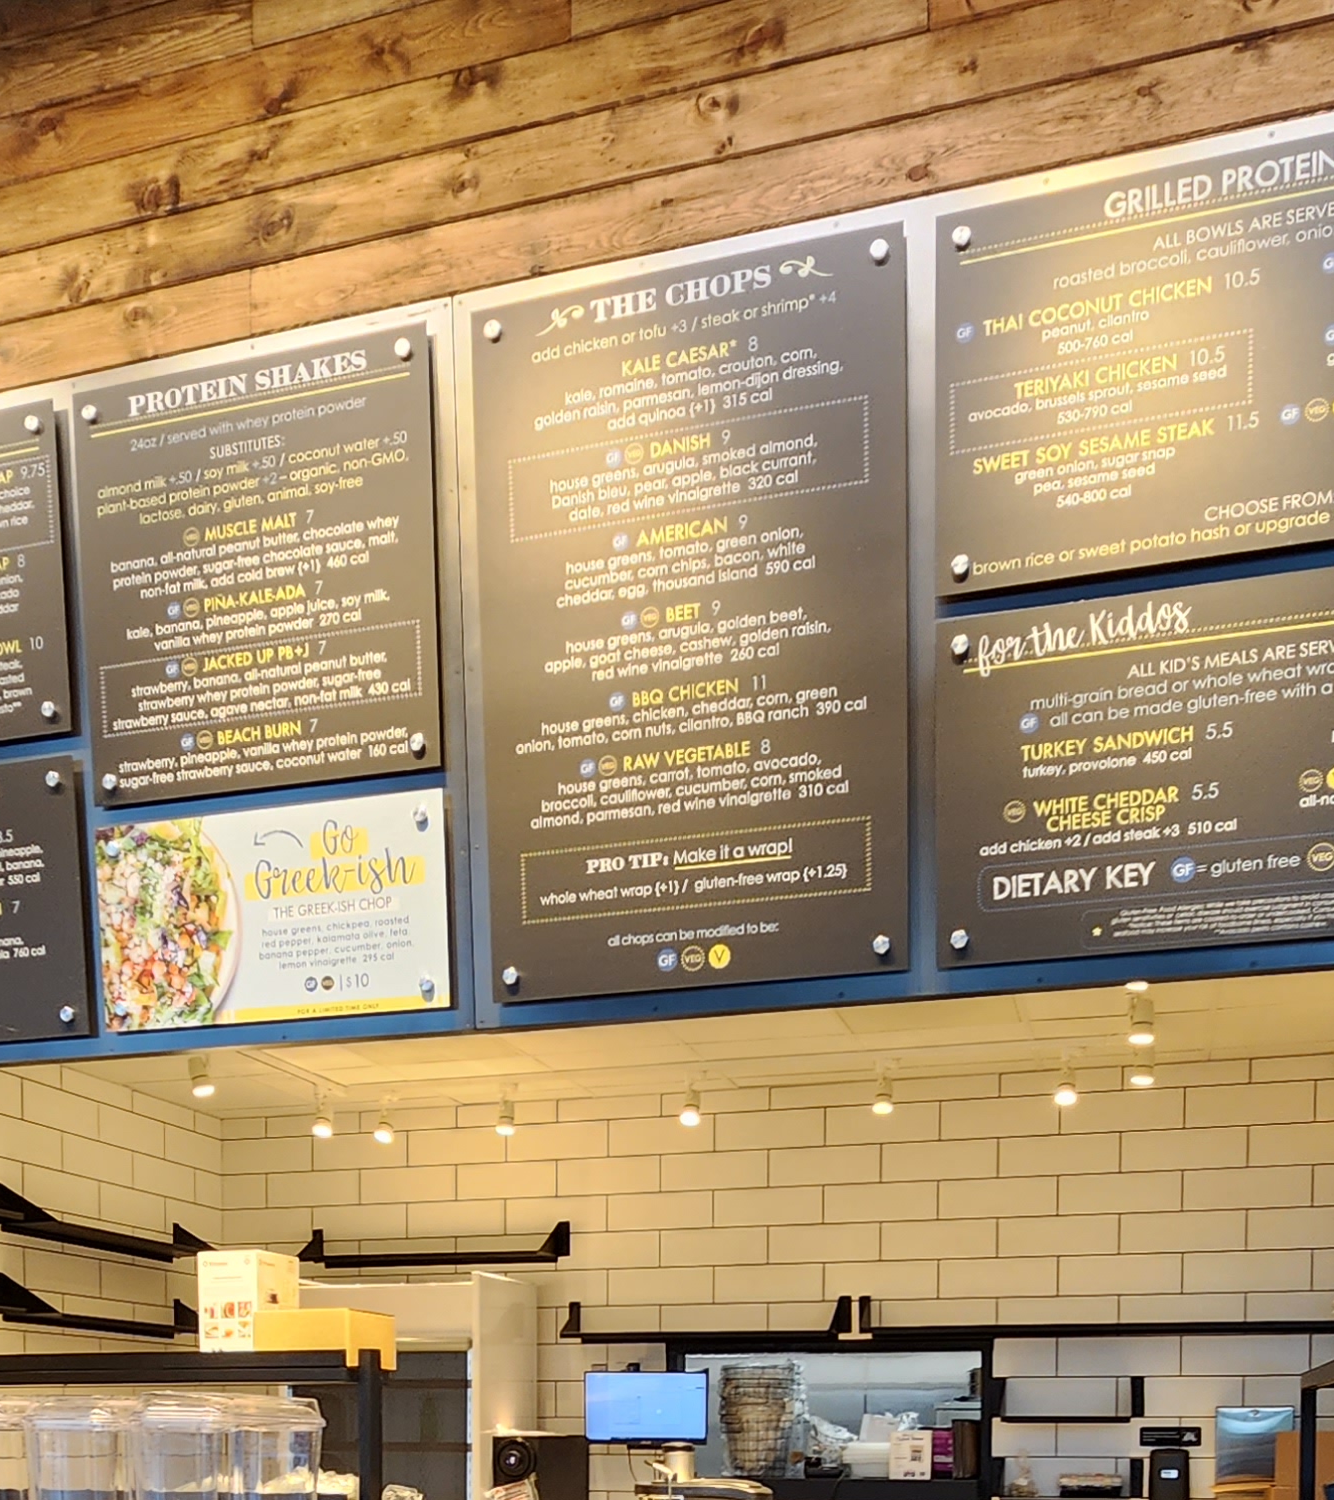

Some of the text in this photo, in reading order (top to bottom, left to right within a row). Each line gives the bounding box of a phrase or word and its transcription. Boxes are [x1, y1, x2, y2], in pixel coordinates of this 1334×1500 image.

[1103, 174, 1213, 219] GRILLED
[1153, 233, 1181, 250] ALL
[1187, 220, 1243, 244] BOWLS
[1249, 212, 1282, 232] ARE
[591, 265, 771, 322] THE CHOPS
[983, 268, 1260, 336] THAI COCONUT CHICKEN 10.5
[622, 354, 660, 376] KALE
[749, 336, 758, 351] 8
[127, 349, 367, 417] PROTEIN SHAKES
[131, 437, 156, 451] 24oz
[167, 425, 206, 445] served
[209, 421, 233, 435] with
[236, 416, 269, 430] whey
[272, 406, 315, 426] protein
[318, 397, 366, 417] powder
[210, 435, 284, 459] SUBSTITUTES:
[650, 429, 730, 457] DANISH 9
[21, 461, 49, 478] 9.75
[205, 509, 313, 541] MUSCLE MALT 7
[18, 554, 24, 567] 8
[30, 636, 43, 649] 10
[977, 600, 1192, 677] for the Kiddos
[322, 819, 359, 855] Go
[585, 837, 793, 874] PRO TIP: Make it a wrap!
[254, 848, 416, 899] Greek-ish
[993, 861, 1155, 900] DIETARY KEY
[1206, 858, 1263, 877] gluten
[1267, 854, 1301, 868] free
[540, 892, 576, 905] whole
[579, 886, 617, 901] wheat
[620, 885, 652, 898] wrap
[695, 873, 763, 893] gluten-free
[766, 871, 800, 883] wrap
[273, 896, 392, 919] THE GREEK-ISH CHOP
